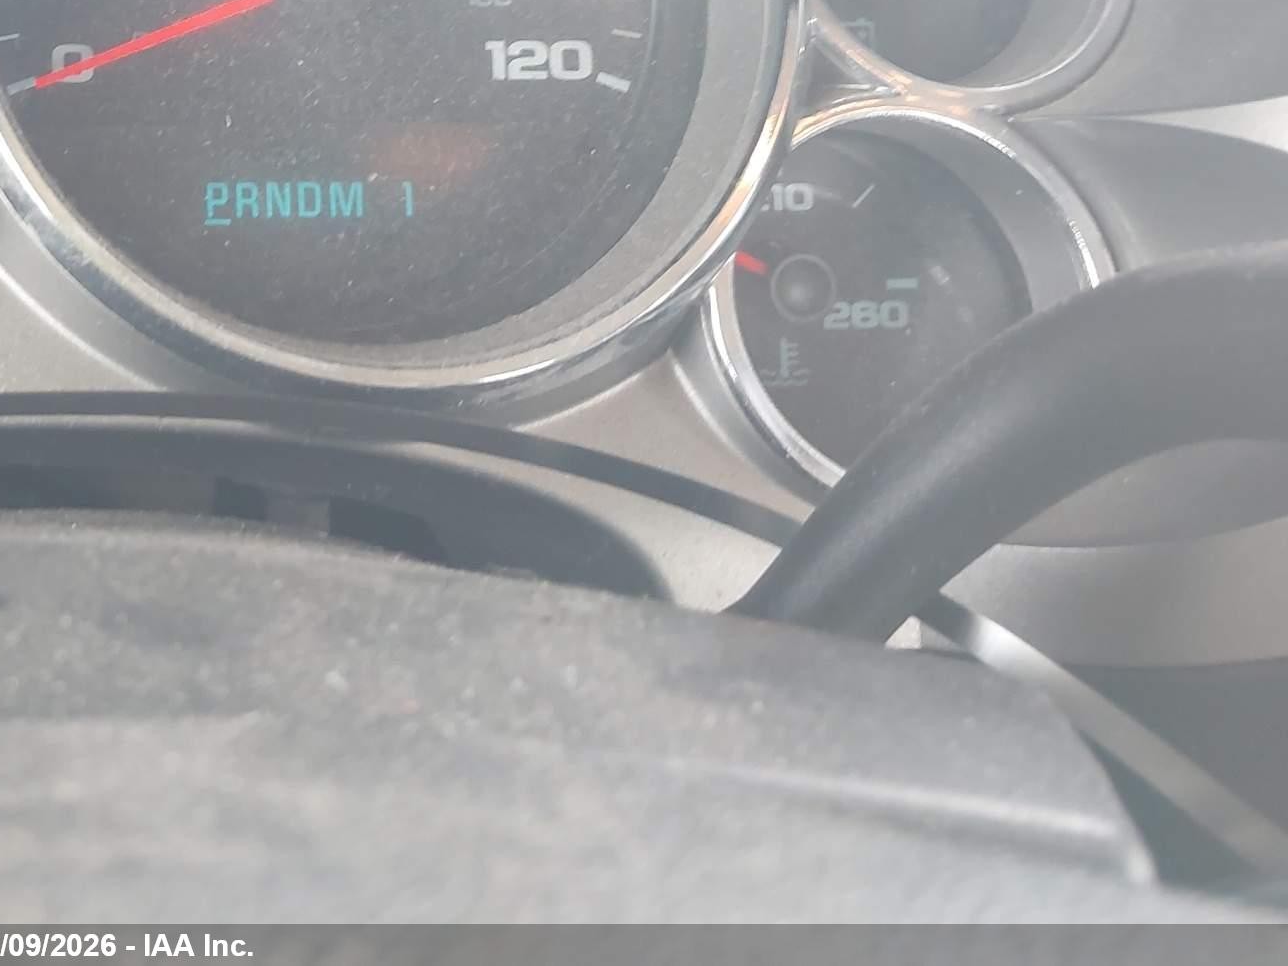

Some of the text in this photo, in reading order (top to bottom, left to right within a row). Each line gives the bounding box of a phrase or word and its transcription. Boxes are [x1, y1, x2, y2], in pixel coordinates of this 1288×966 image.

[485, 41, 592, 80] 120
[205, 181, 413, 223] PRNDM 1
